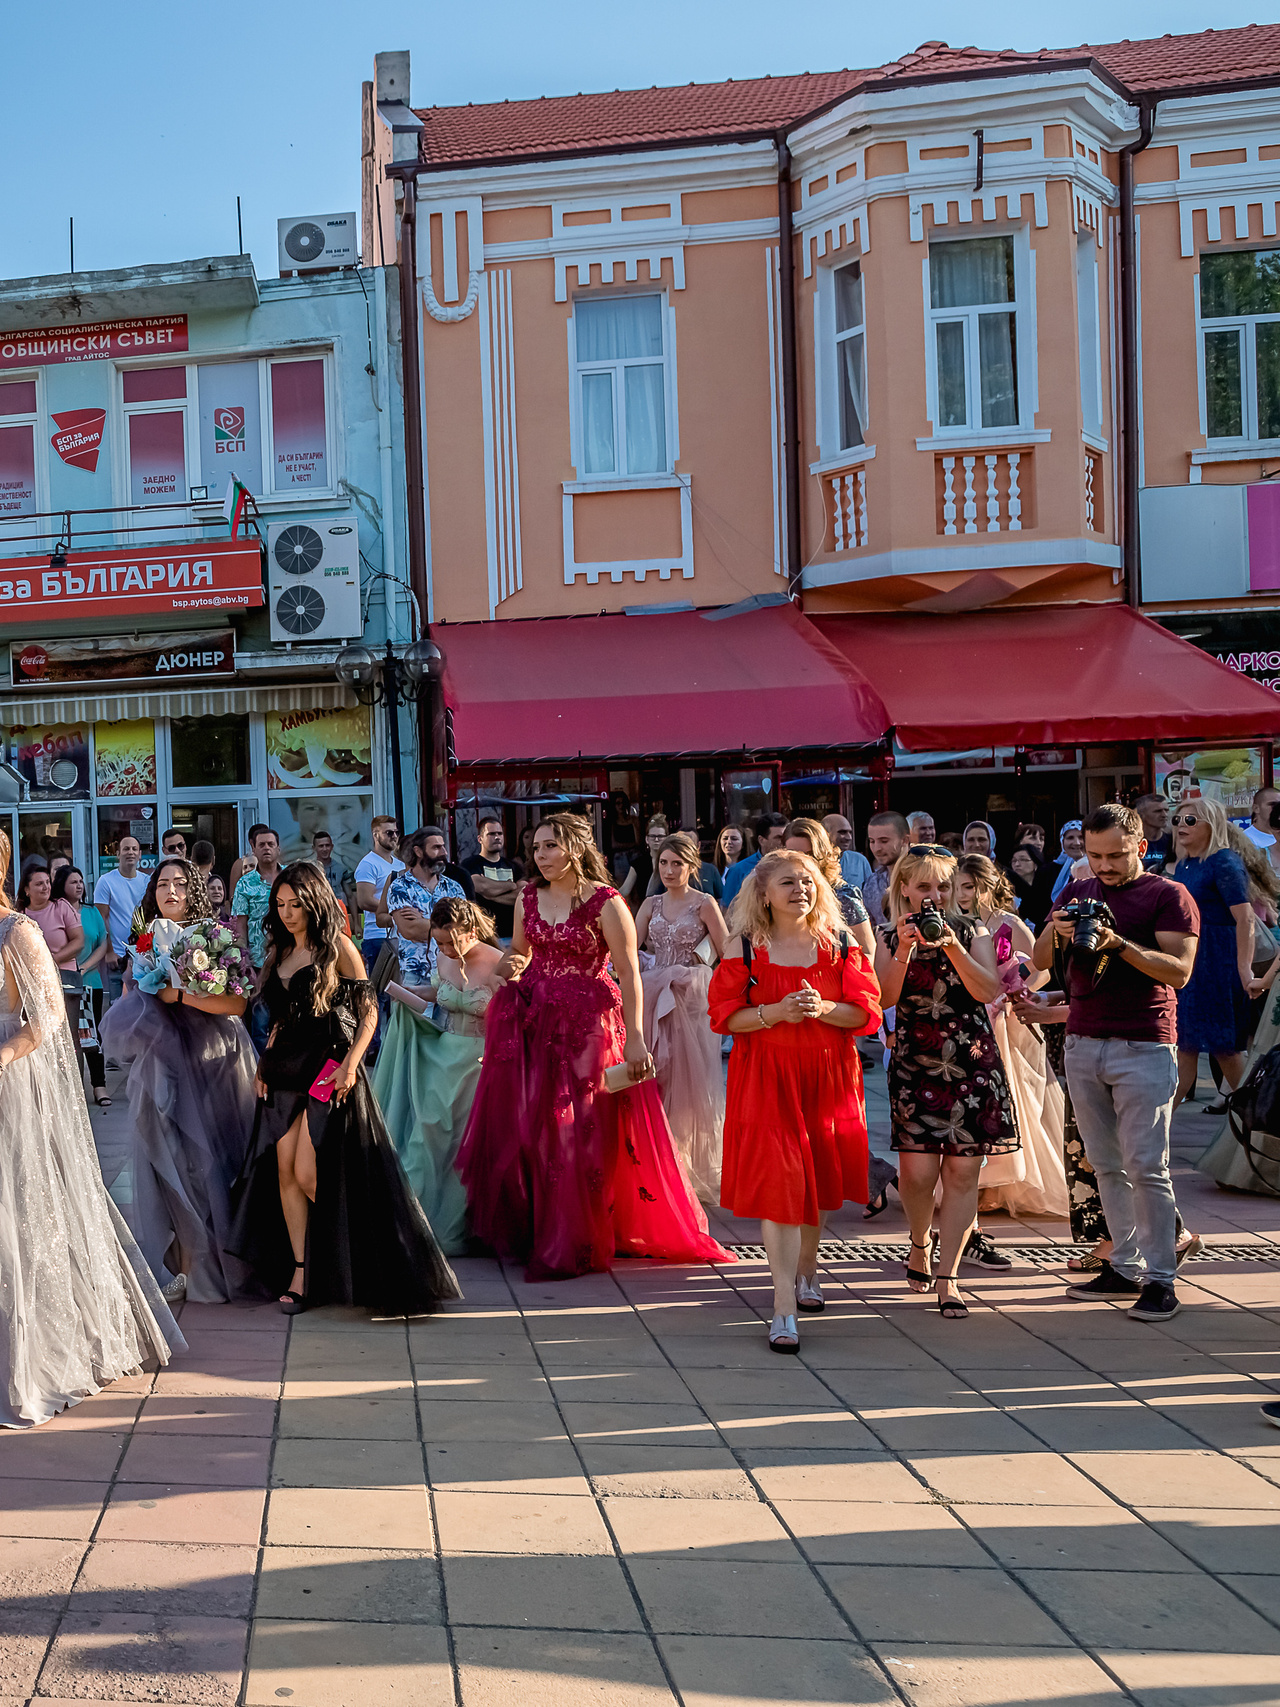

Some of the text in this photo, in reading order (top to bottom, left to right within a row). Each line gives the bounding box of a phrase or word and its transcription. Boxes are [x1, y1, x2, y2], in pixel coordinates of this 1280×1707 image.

[48, 320, 144, 336] СОЦИАЛИСТИЧЕСКА
[145, 317, 184, 327] ПАРТИЯ
[1, 329, 174, 358] ОБЩИНСКИ СЪВЕТ
[83, 352, 110, 360] АЙТОС
[56, 434, 73, 446] БСП
[58, 432, 100, 453] БЪЛГАРИЯ
[215, 440, 245, 453] БСП
[278, 454, 286, 463] ДА
[286, 453, 294, 461] СИ
[285, 464, 293, 472] НЕ
[142, 475, 176, 485] ЗАЕДНО
[143, 485, 176, 495] МОЖЕМ
[0, 502, 22, 511] БЪДЕЩЕ
[0, 579, 32, 600] за
[41, 560, 213, 597] БЪЛГАРИЯ
[172, 595, 249, 608] bsp.aytos@abv.bg
[155, 650, 225, 672] ДЮНЕР
[19, 730, 84, 760] кебап
[1097, 954, 1109, 974] Nikon
